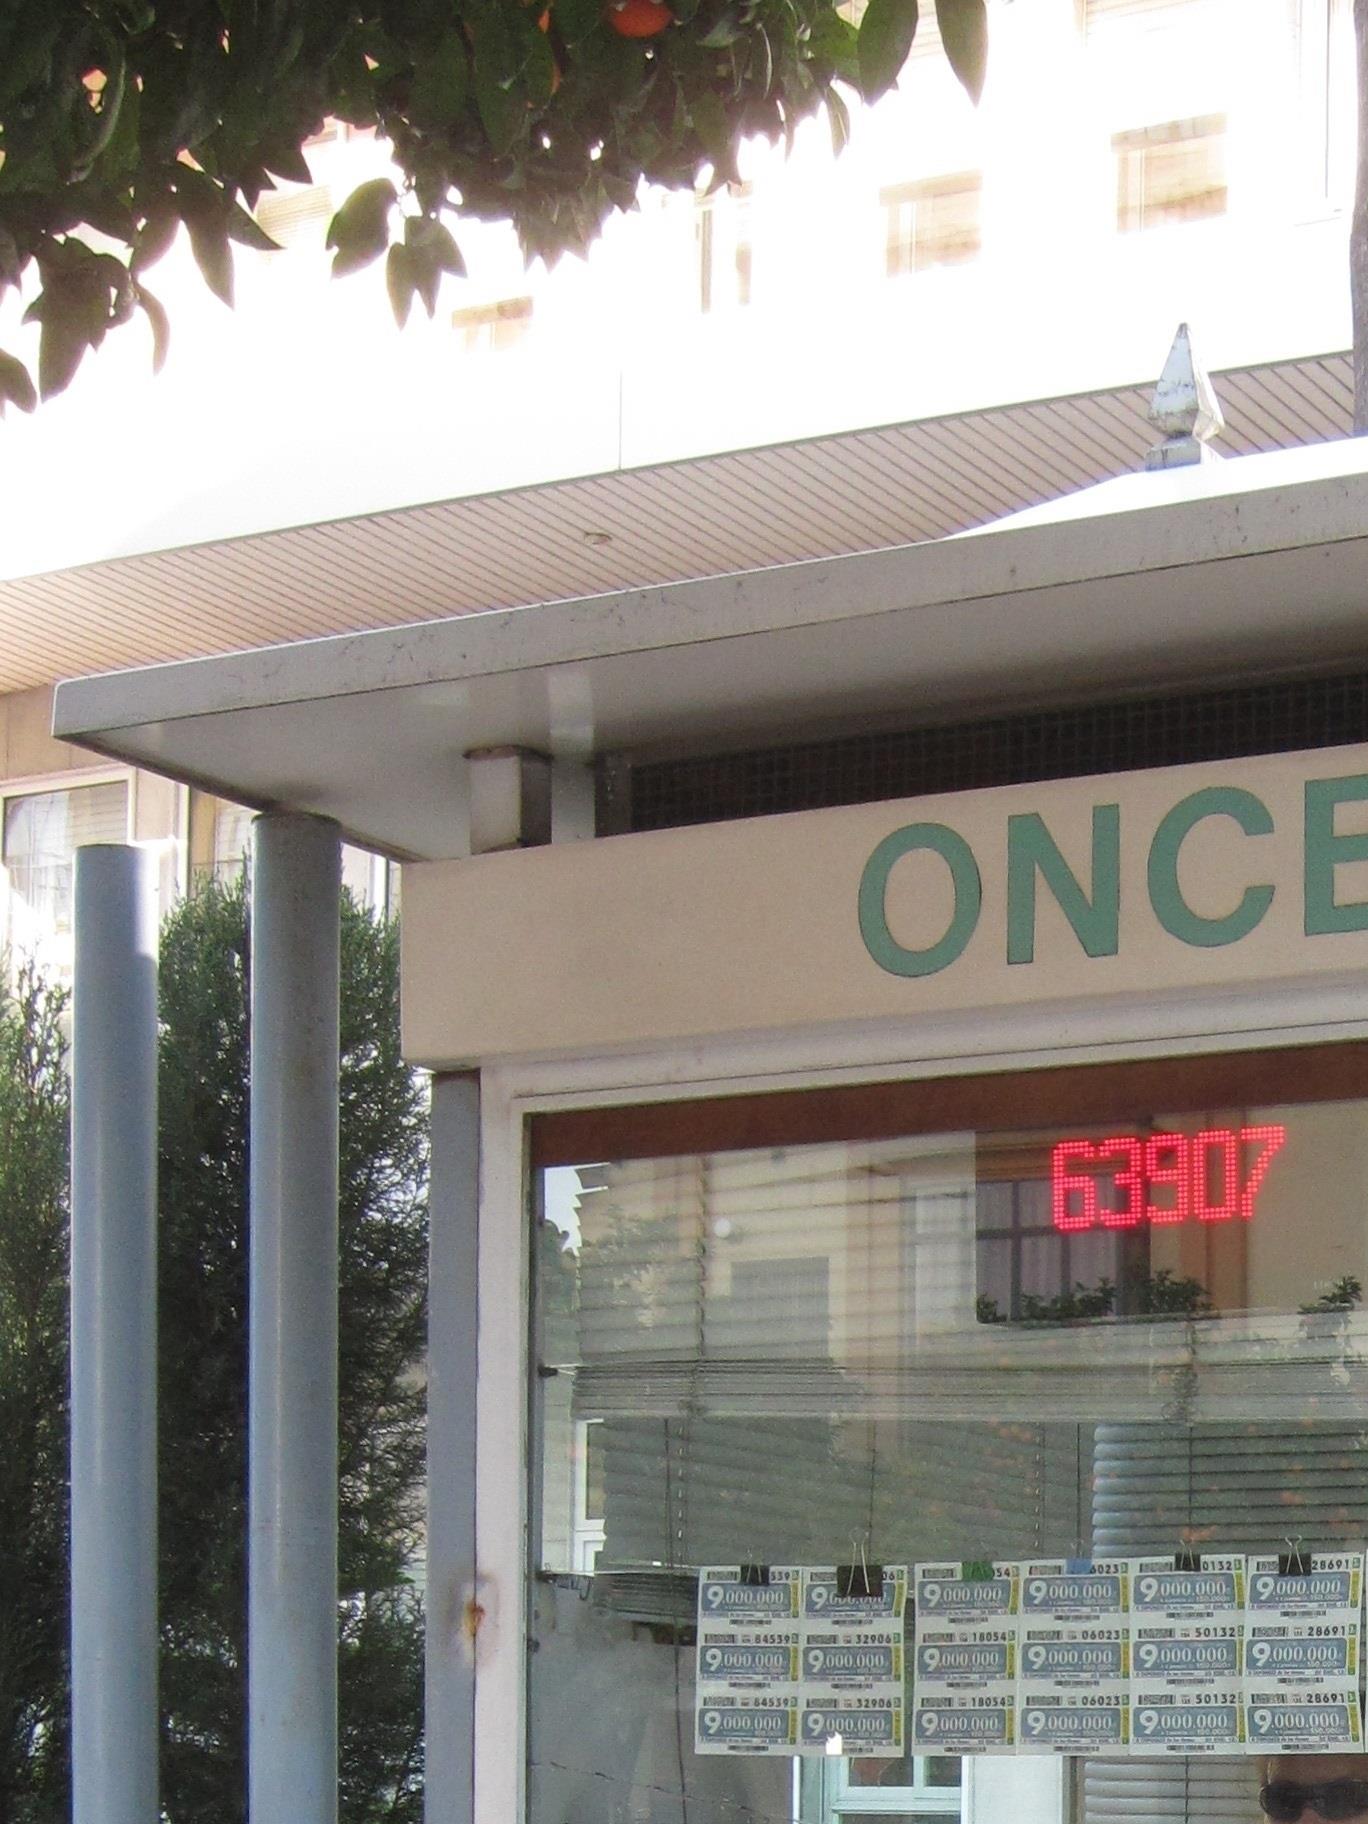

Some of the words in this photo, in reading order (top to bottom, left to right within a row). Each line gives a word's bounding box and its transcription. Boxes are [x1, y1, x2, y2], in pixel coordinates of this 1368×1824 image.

[1053, 1126, 1285, 1230] 63907
[1090, 1564, 1119, 1574] 6023
[1202, 1560, 1232, 1571] 0132
[1195, 1627, 1236, 1637] 50132
[1308, 1625, 1345, 1637] 28691
[1195, 1694, 1236, 1704] 50132
[1307, 1692, 1345, 1704] 28691
